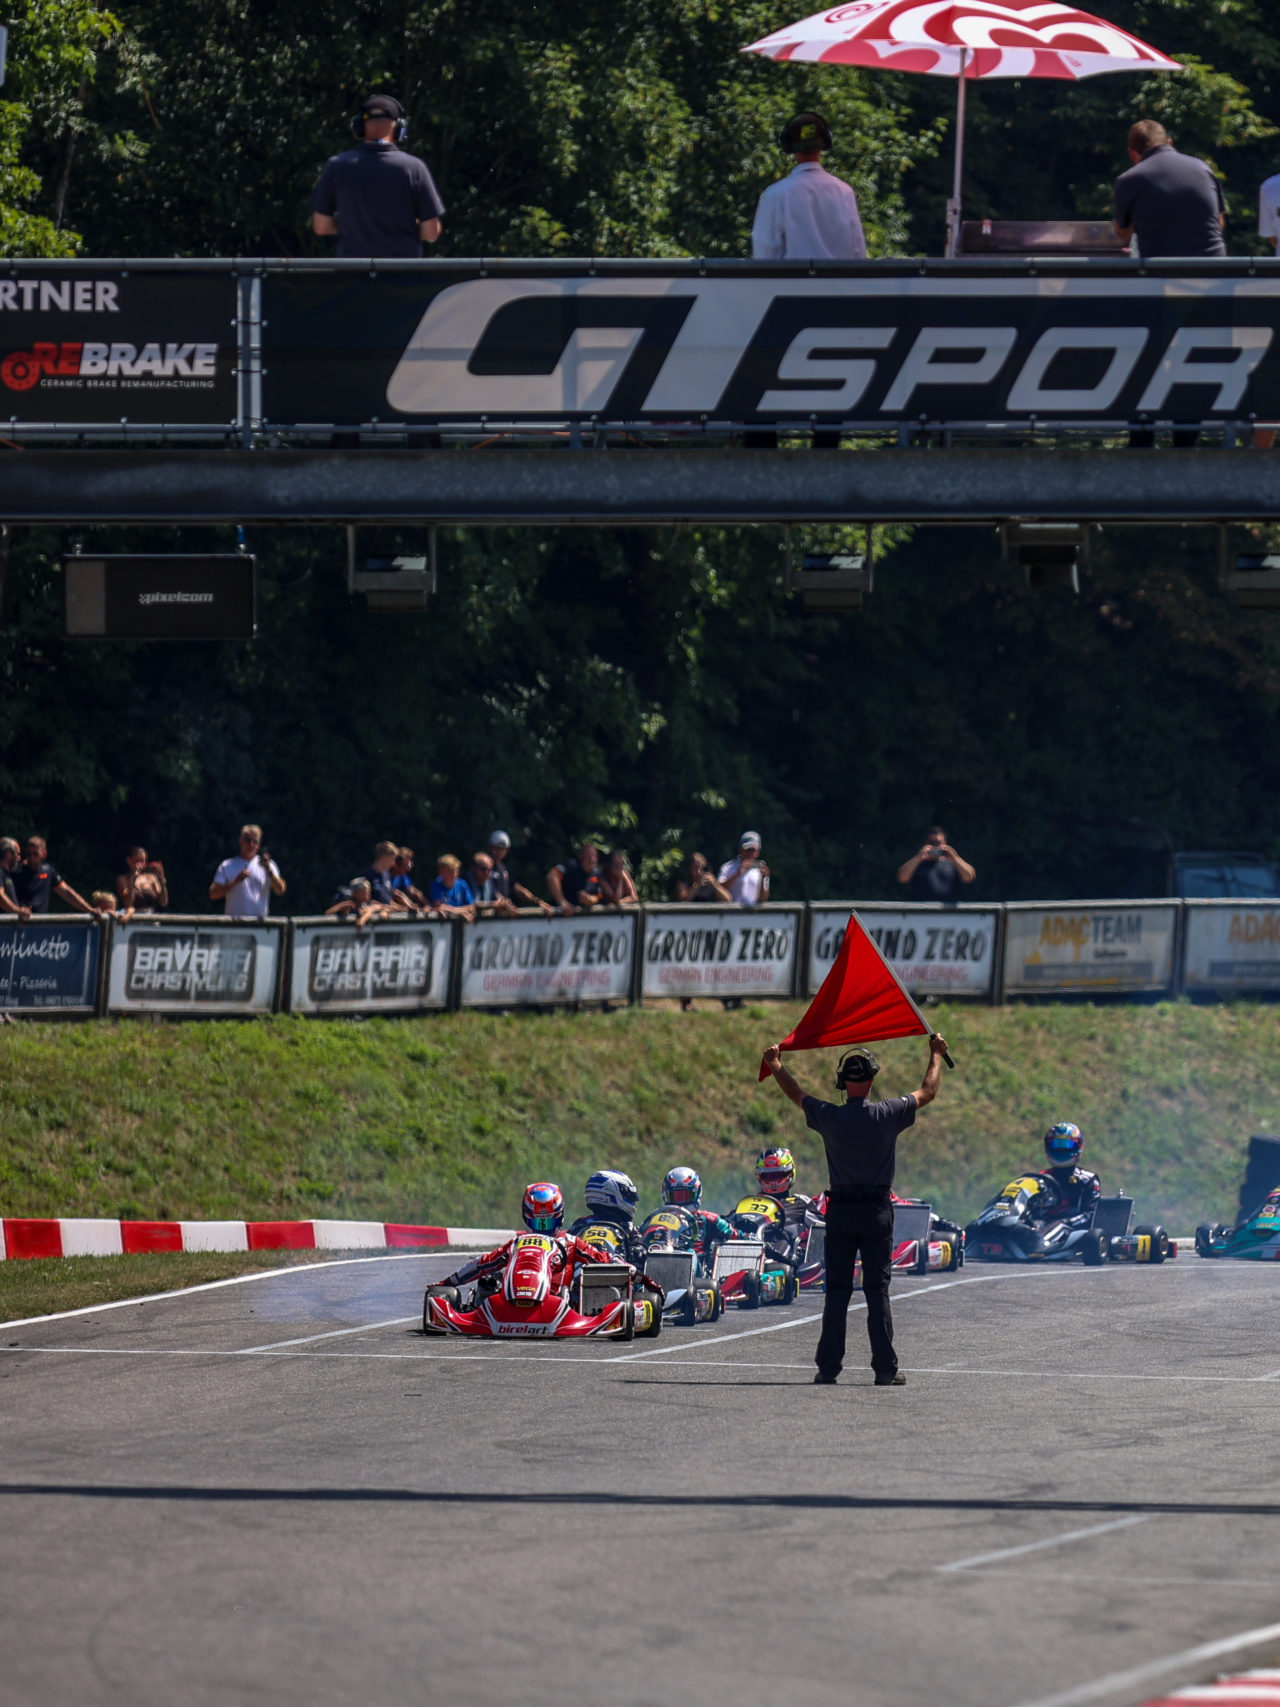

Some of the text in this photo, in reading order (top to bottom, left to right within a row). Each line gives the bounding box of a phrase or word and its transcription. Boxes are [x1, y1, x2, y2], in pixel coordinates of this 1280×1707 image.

[33, 342, 218, 376] REBRAKE
[40, 379, 214, 388] CERAMIC BRAKE REMANUFACTURING
[1091, 913, 1143, 944] TEAM
[469, 929, 628, 971] GROUND ZERO
[648, 927, 789, 963] GROUND ZERO
[923, 928, 985, 961] ZERO
[751, 1203, 768, 1213] 33
[522, 1238, 543, 1247] 88
[586, 1229, 608, 1238] 58
[498, 1325, 549, 1335] birelart
